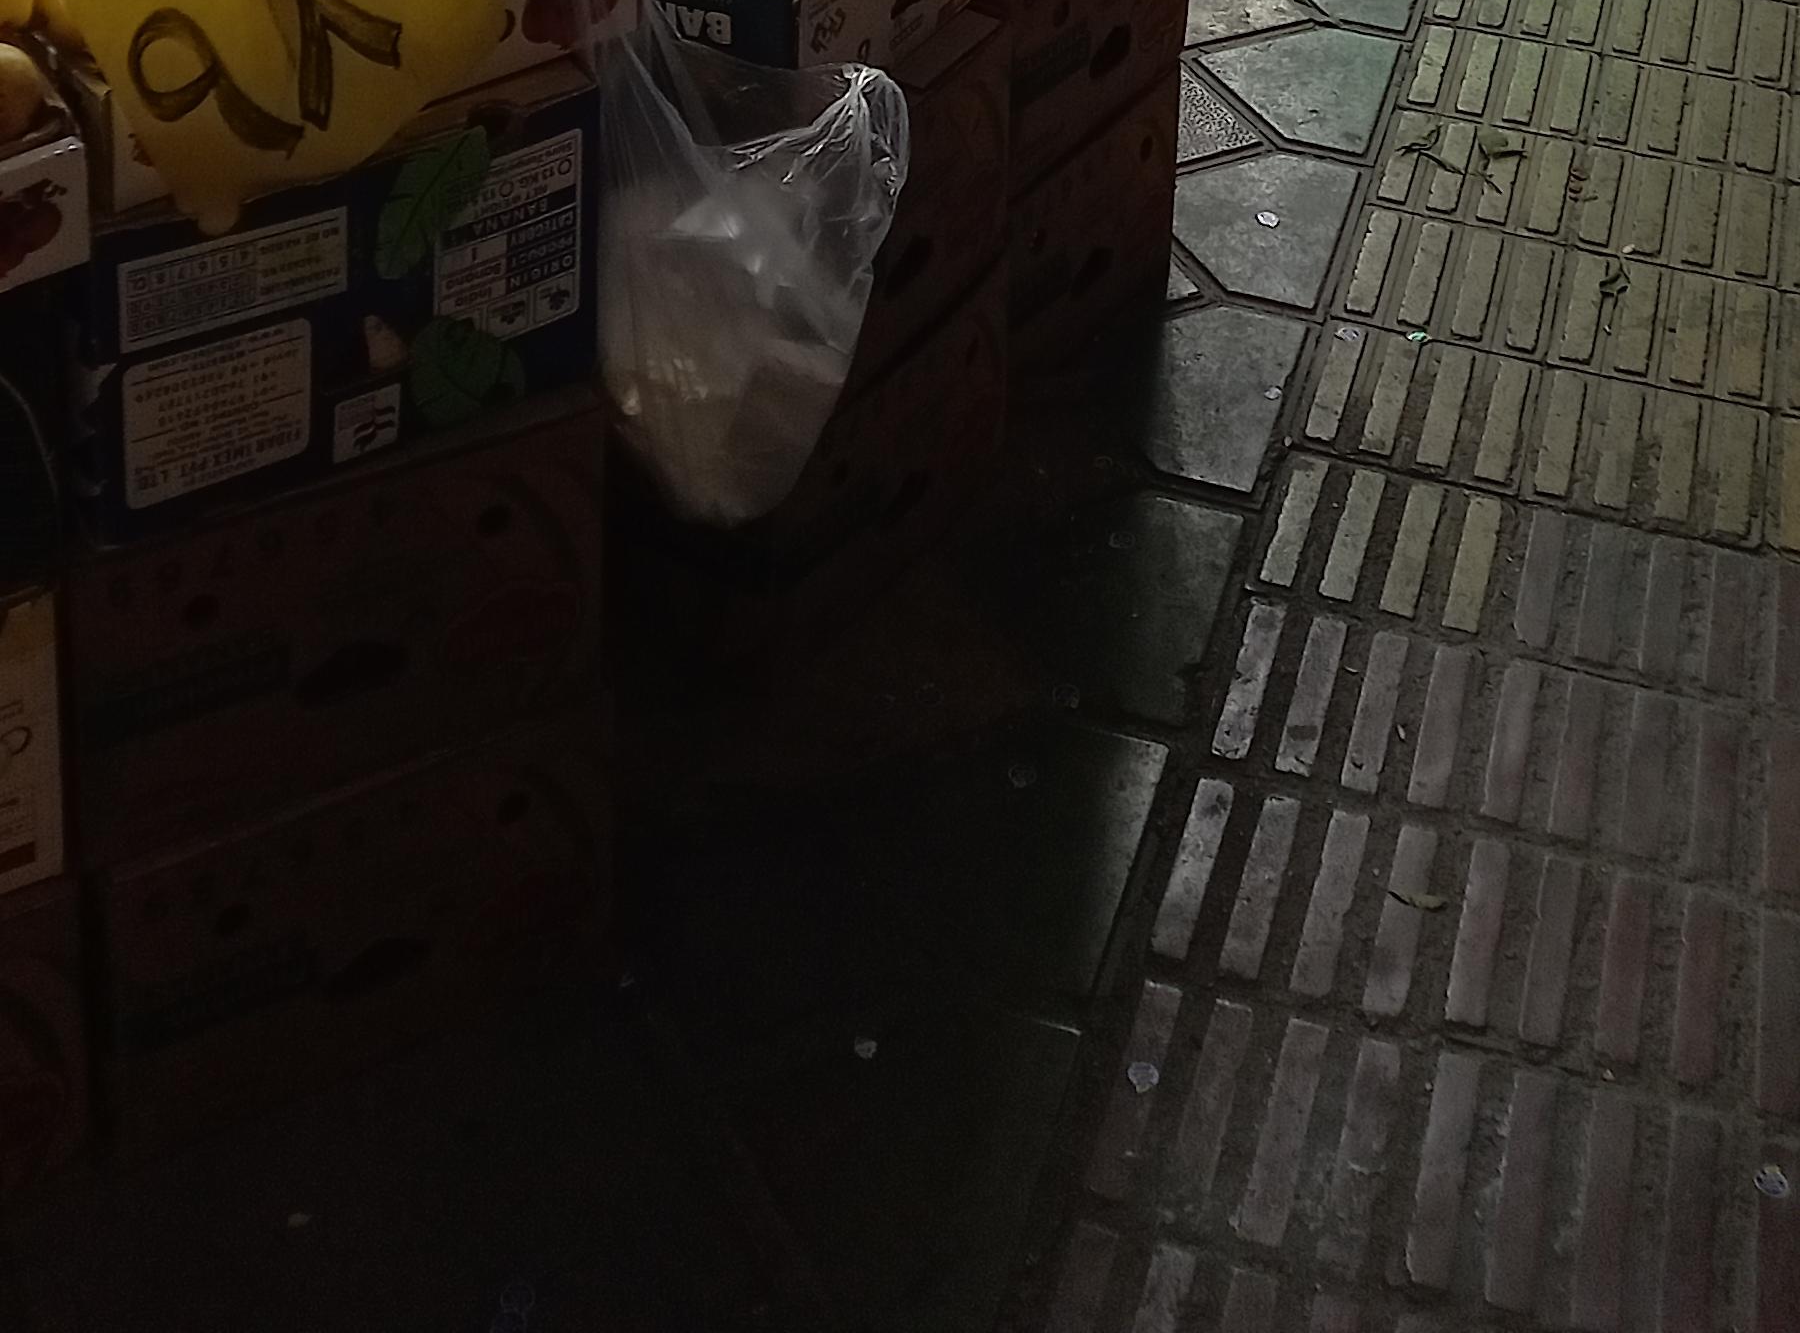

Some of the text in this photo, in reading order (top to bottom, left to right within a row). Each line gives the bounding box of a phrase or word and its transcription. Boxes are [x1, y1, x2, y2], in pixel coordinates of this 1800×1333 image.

[472, 197, 549, 237] BANANA
[511, 210, 575, 247] CATEGORY
[445, 234, 575, 290] PRODUCT Banana
[454, 253, 575, 308] ORIGIN India
